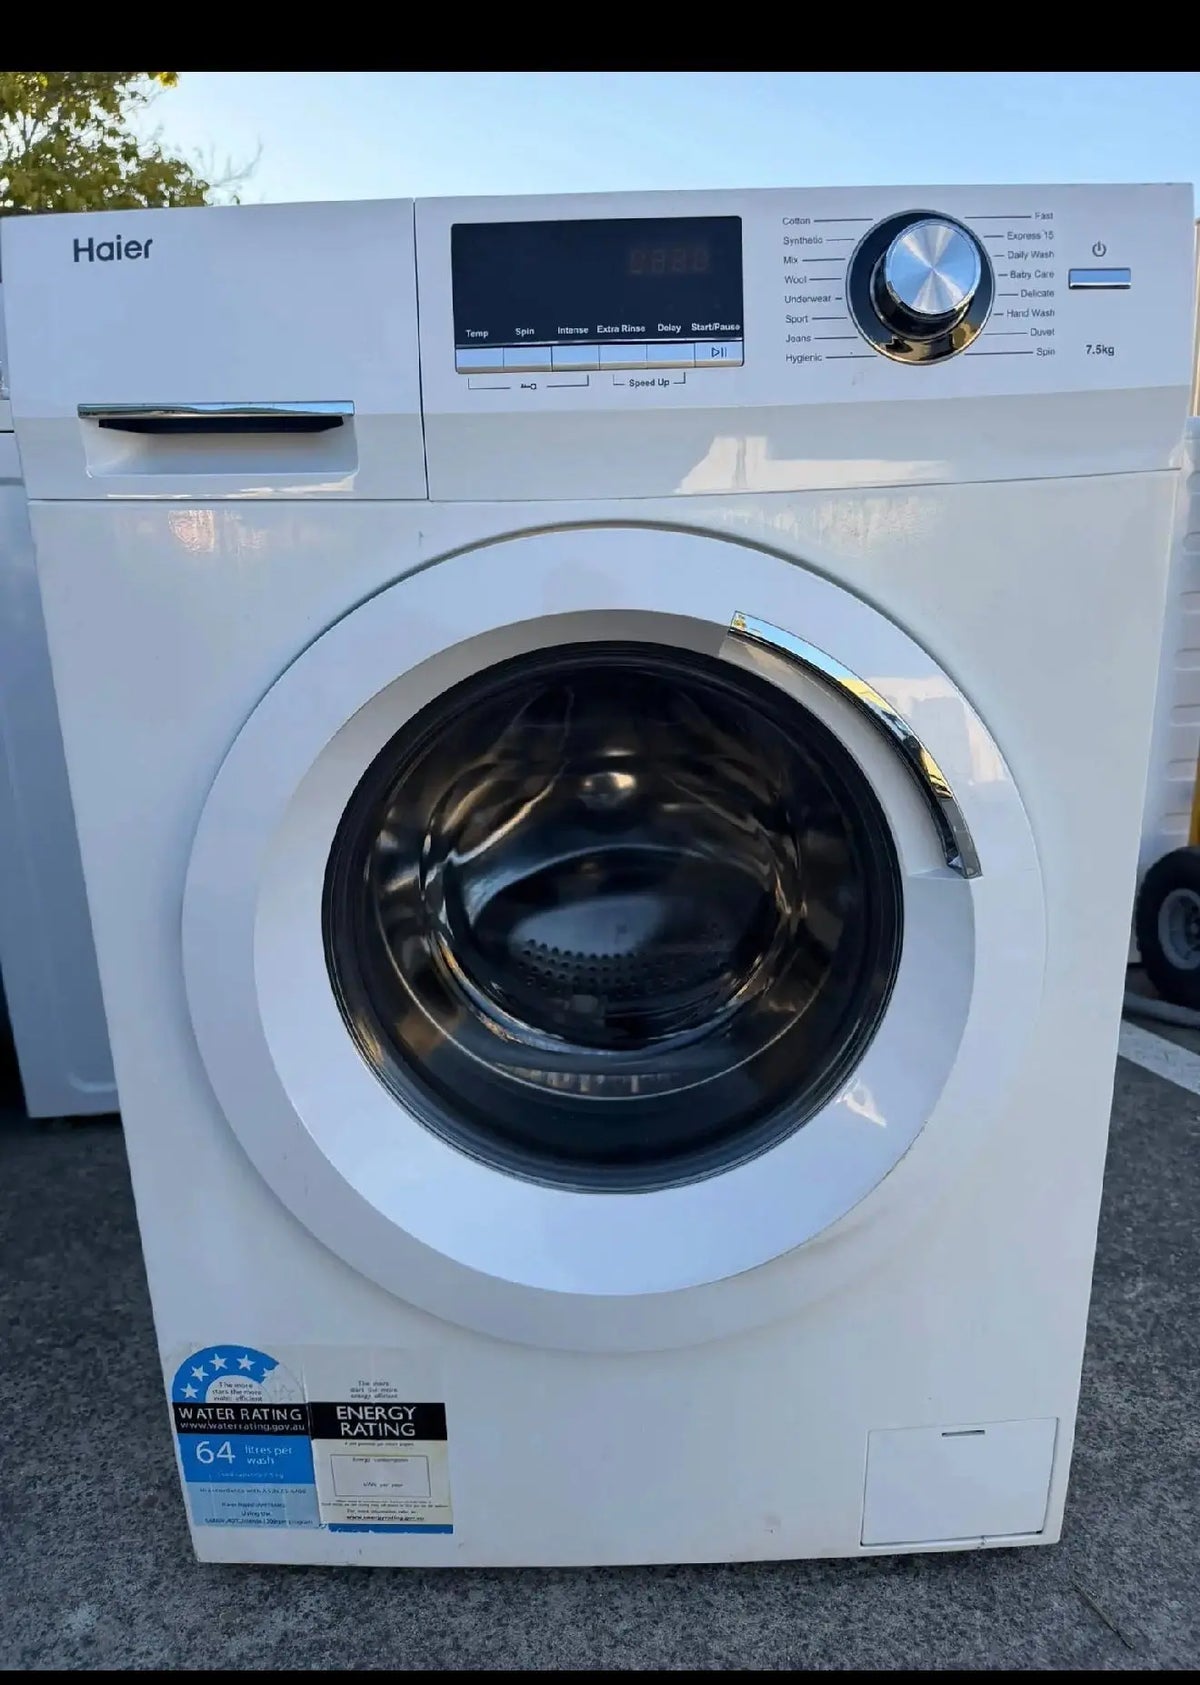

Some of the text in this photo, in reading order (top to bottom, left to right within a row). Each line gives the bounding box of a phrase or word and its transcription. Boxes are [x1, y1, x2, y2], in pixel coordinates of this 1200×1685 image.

[1035, 212, 1053, 220] Fast
[783, 237, 823, 245] Synthetic
[1007, 232, 1041, 241] Express
[73, 235, 153, 263] Haier
[783, 256, 798, 264] Mix
[1008, 251, 1054, 260] Daily Wash
[1010, 271, 1031, 279] Baby
[785, 276, 807, 284] Wool
[1021, 289, 1054, 297] Delicate
[785, 295, 831, 303] Underwear
[785, 315, 808, 323] Sport
[515, 327, 535, 336] Spin
[558, 326, 589, 334] Intense
[597, 324, 646, 333] Extra Rinse
[658, 323, 682, 334] Delay
[691, 322, 740, 332] Start/Pause
[466, 330, 488, 338] Temp
[1030, 328, 1054, 336] Duvet
[785, 334, 811, 342] Jeans
[1037, 348, 1055, 357] Spin
[1086, 345, 1115, 356] 7.5kg
[785, 353, 822, 363] Hygienic
[629, 378, 670, 388] Speed Up
[179, 1408, 302, 1420] WATER RATING
[336, 1406, 417, 1420] ENERGY
[180, 1421, 305, 1431] www.waterrating.gov.au
[341, 1422, 416, 1437] RATING
[196, 1440, 236, 1464] 64
[245, 1445, 293, 1456] litres per
[247, 1456, 275, 1465] wash
